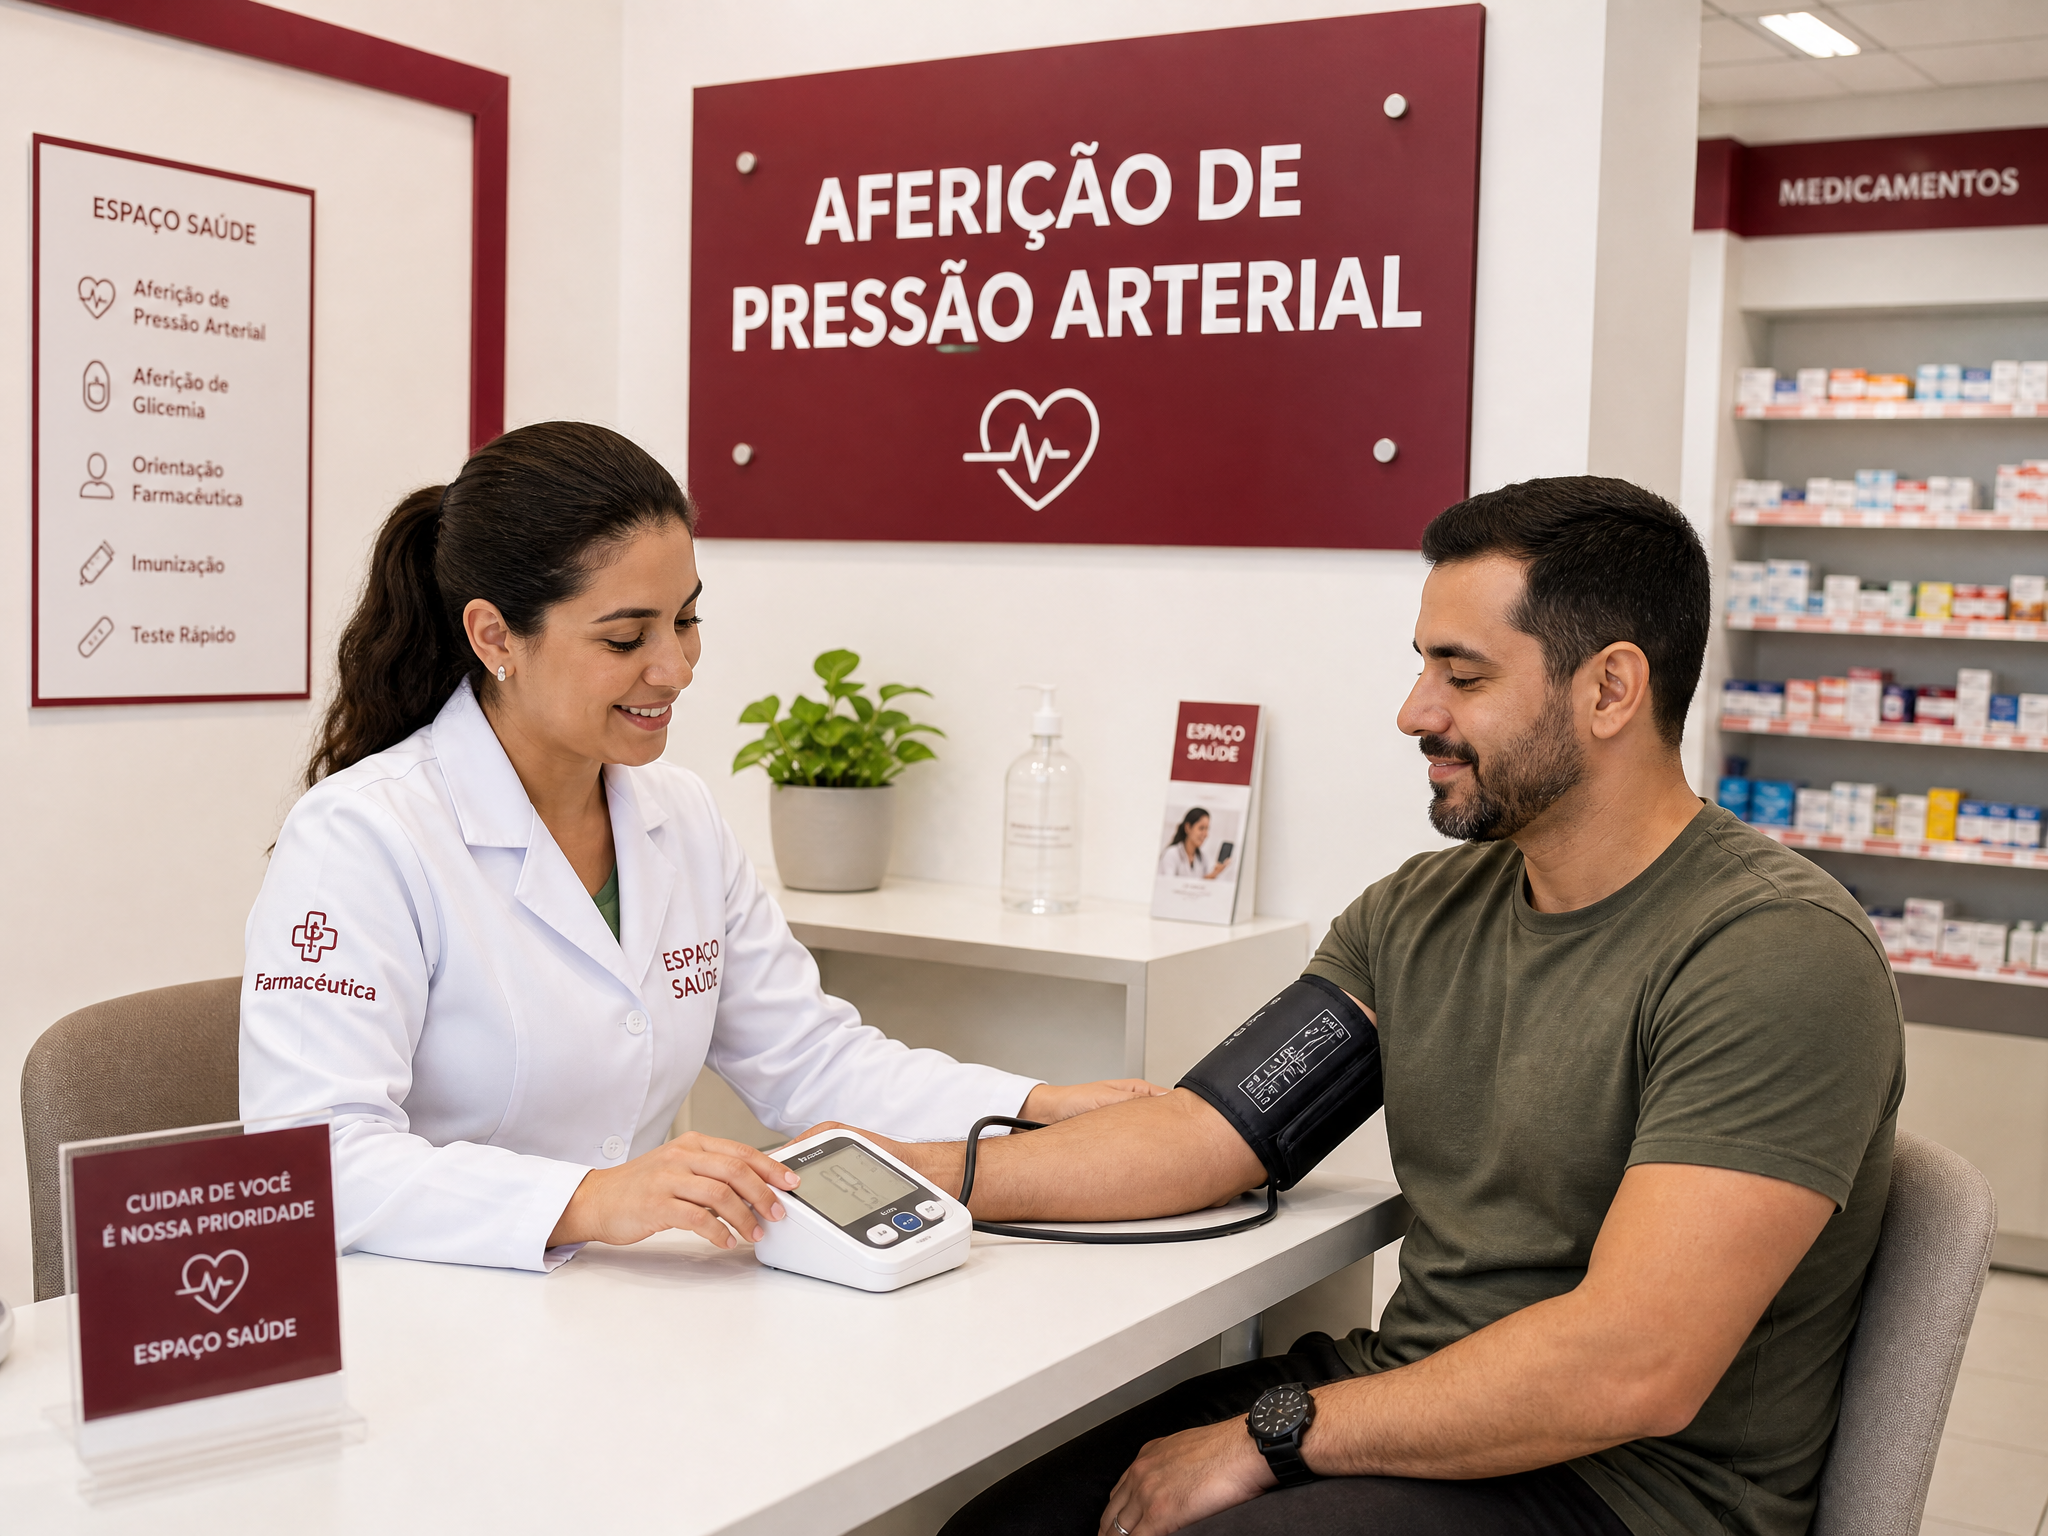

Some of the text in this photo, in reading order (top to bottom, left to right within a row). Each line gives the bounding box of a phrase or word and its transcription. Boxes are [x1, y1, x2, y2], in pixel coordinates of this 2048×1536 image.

[806, 141, 1301, 250] AFERIÇÃO DE
[1779, 168, 2019, 206] MEDICAMENTOS
[93, 196, 255, 245] ESPAÇO SAÚDE
[134, 278, 229, 309] Aferição de
[732, 254, 1422, 352] PRESSÃO ARTERIAL
[134, 308, 266, 342] Pressão Arterial
[133, 367, 229, 394] Aferição de
[133, 396, 205, 420] Glicemia
[133, 456, 223, 482] Orientação
[132, 554, 225, 577] Imunização
[132, 624, 235, 647] Teste Rápido
[1186, 723, 1245, 744] ESPAÇO
[1188, 742, 1238, 762] SAÚDE
[662, 939, 719, 972] ESPAÇO
[255, 973, 376, 1002] Farmacéutica
[671, 967, 718, 1000] SAÚDE
[126, 1171, 291, 1213] CUIDAR DE VOCÊ
[102, 1201, 315, 1248] É NOSSA PRIORIDADE
[134, 1318, 297, 1365] ESPAÇO SAÚDE
